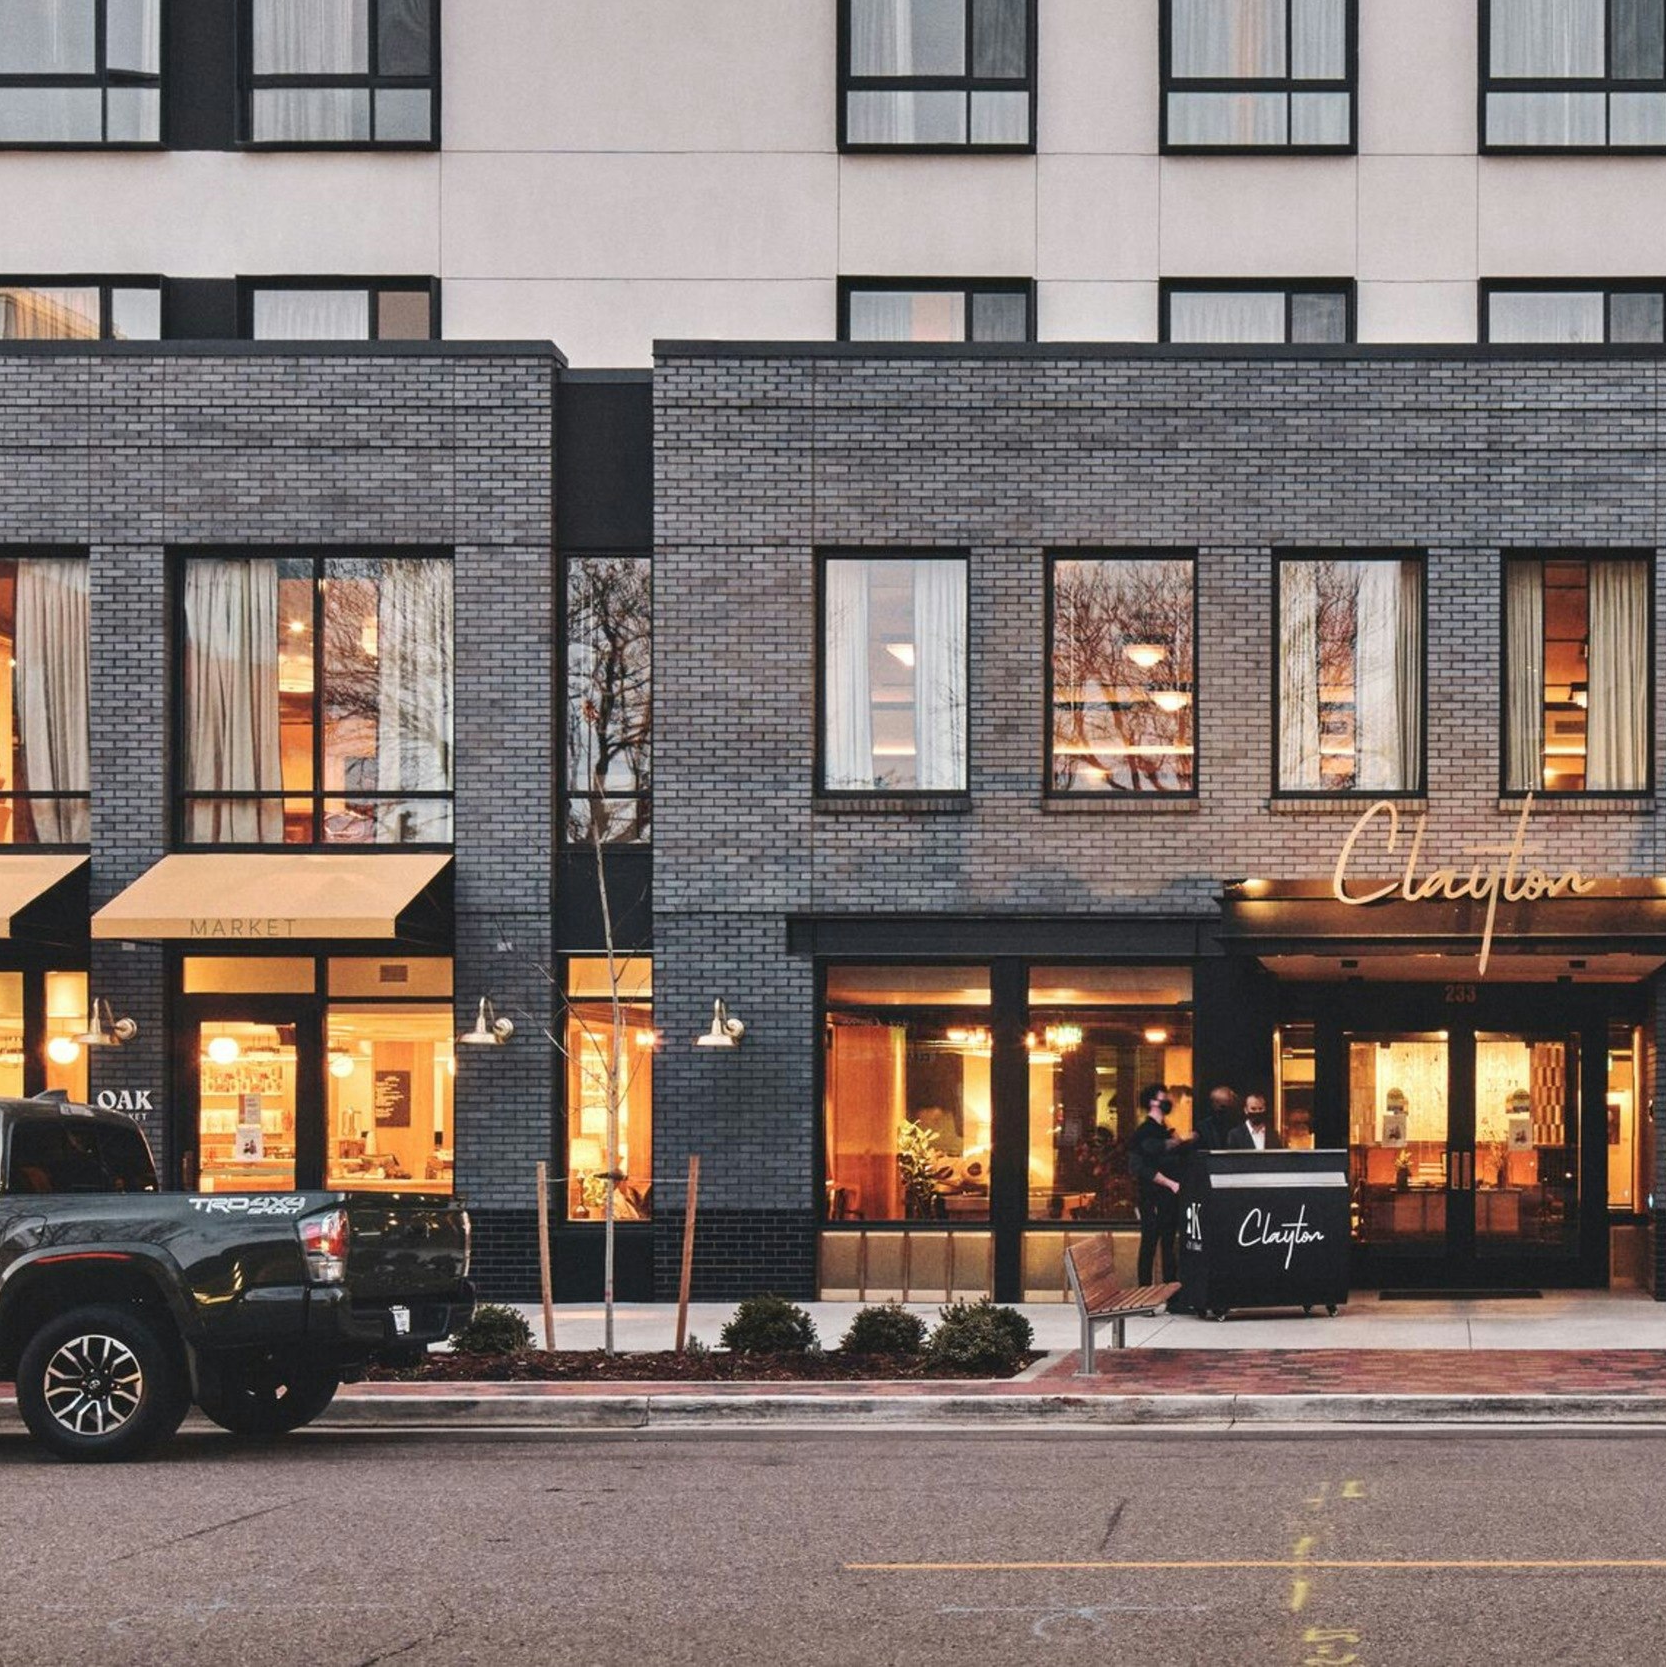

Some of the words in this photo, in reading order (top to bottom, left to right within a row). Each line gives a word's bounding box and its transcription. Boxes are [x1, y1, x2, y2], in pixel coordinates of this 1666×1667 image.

[1333, 792, 1596, 975] Clayton
[190, 918, 296, 936] MARKET
[1444, 984, 1477, 1003] 233
[97, 1090, 153, 1110] OAK
[189, 1197, 251, 1213] TRD
[1238, 1203, 1325, 1270] Clayton
